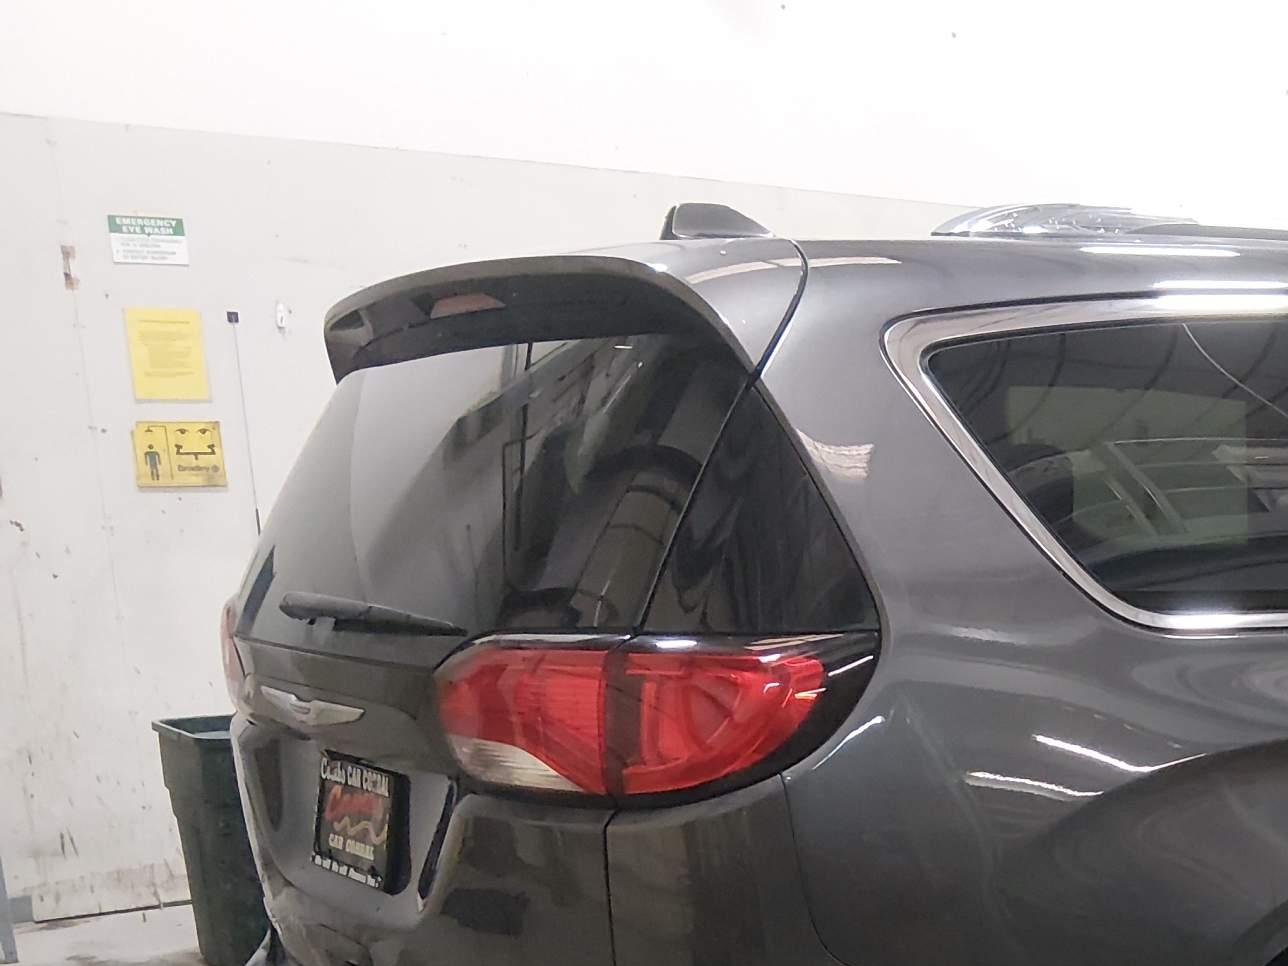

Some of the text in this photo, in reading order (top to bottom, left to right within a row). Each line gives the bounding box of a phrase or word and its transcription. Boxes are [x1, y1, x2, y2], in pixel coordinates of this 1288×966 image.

[115, 217, 177, 228] EMERGENCY
[122, 225, 174, 234] EYE WASH
